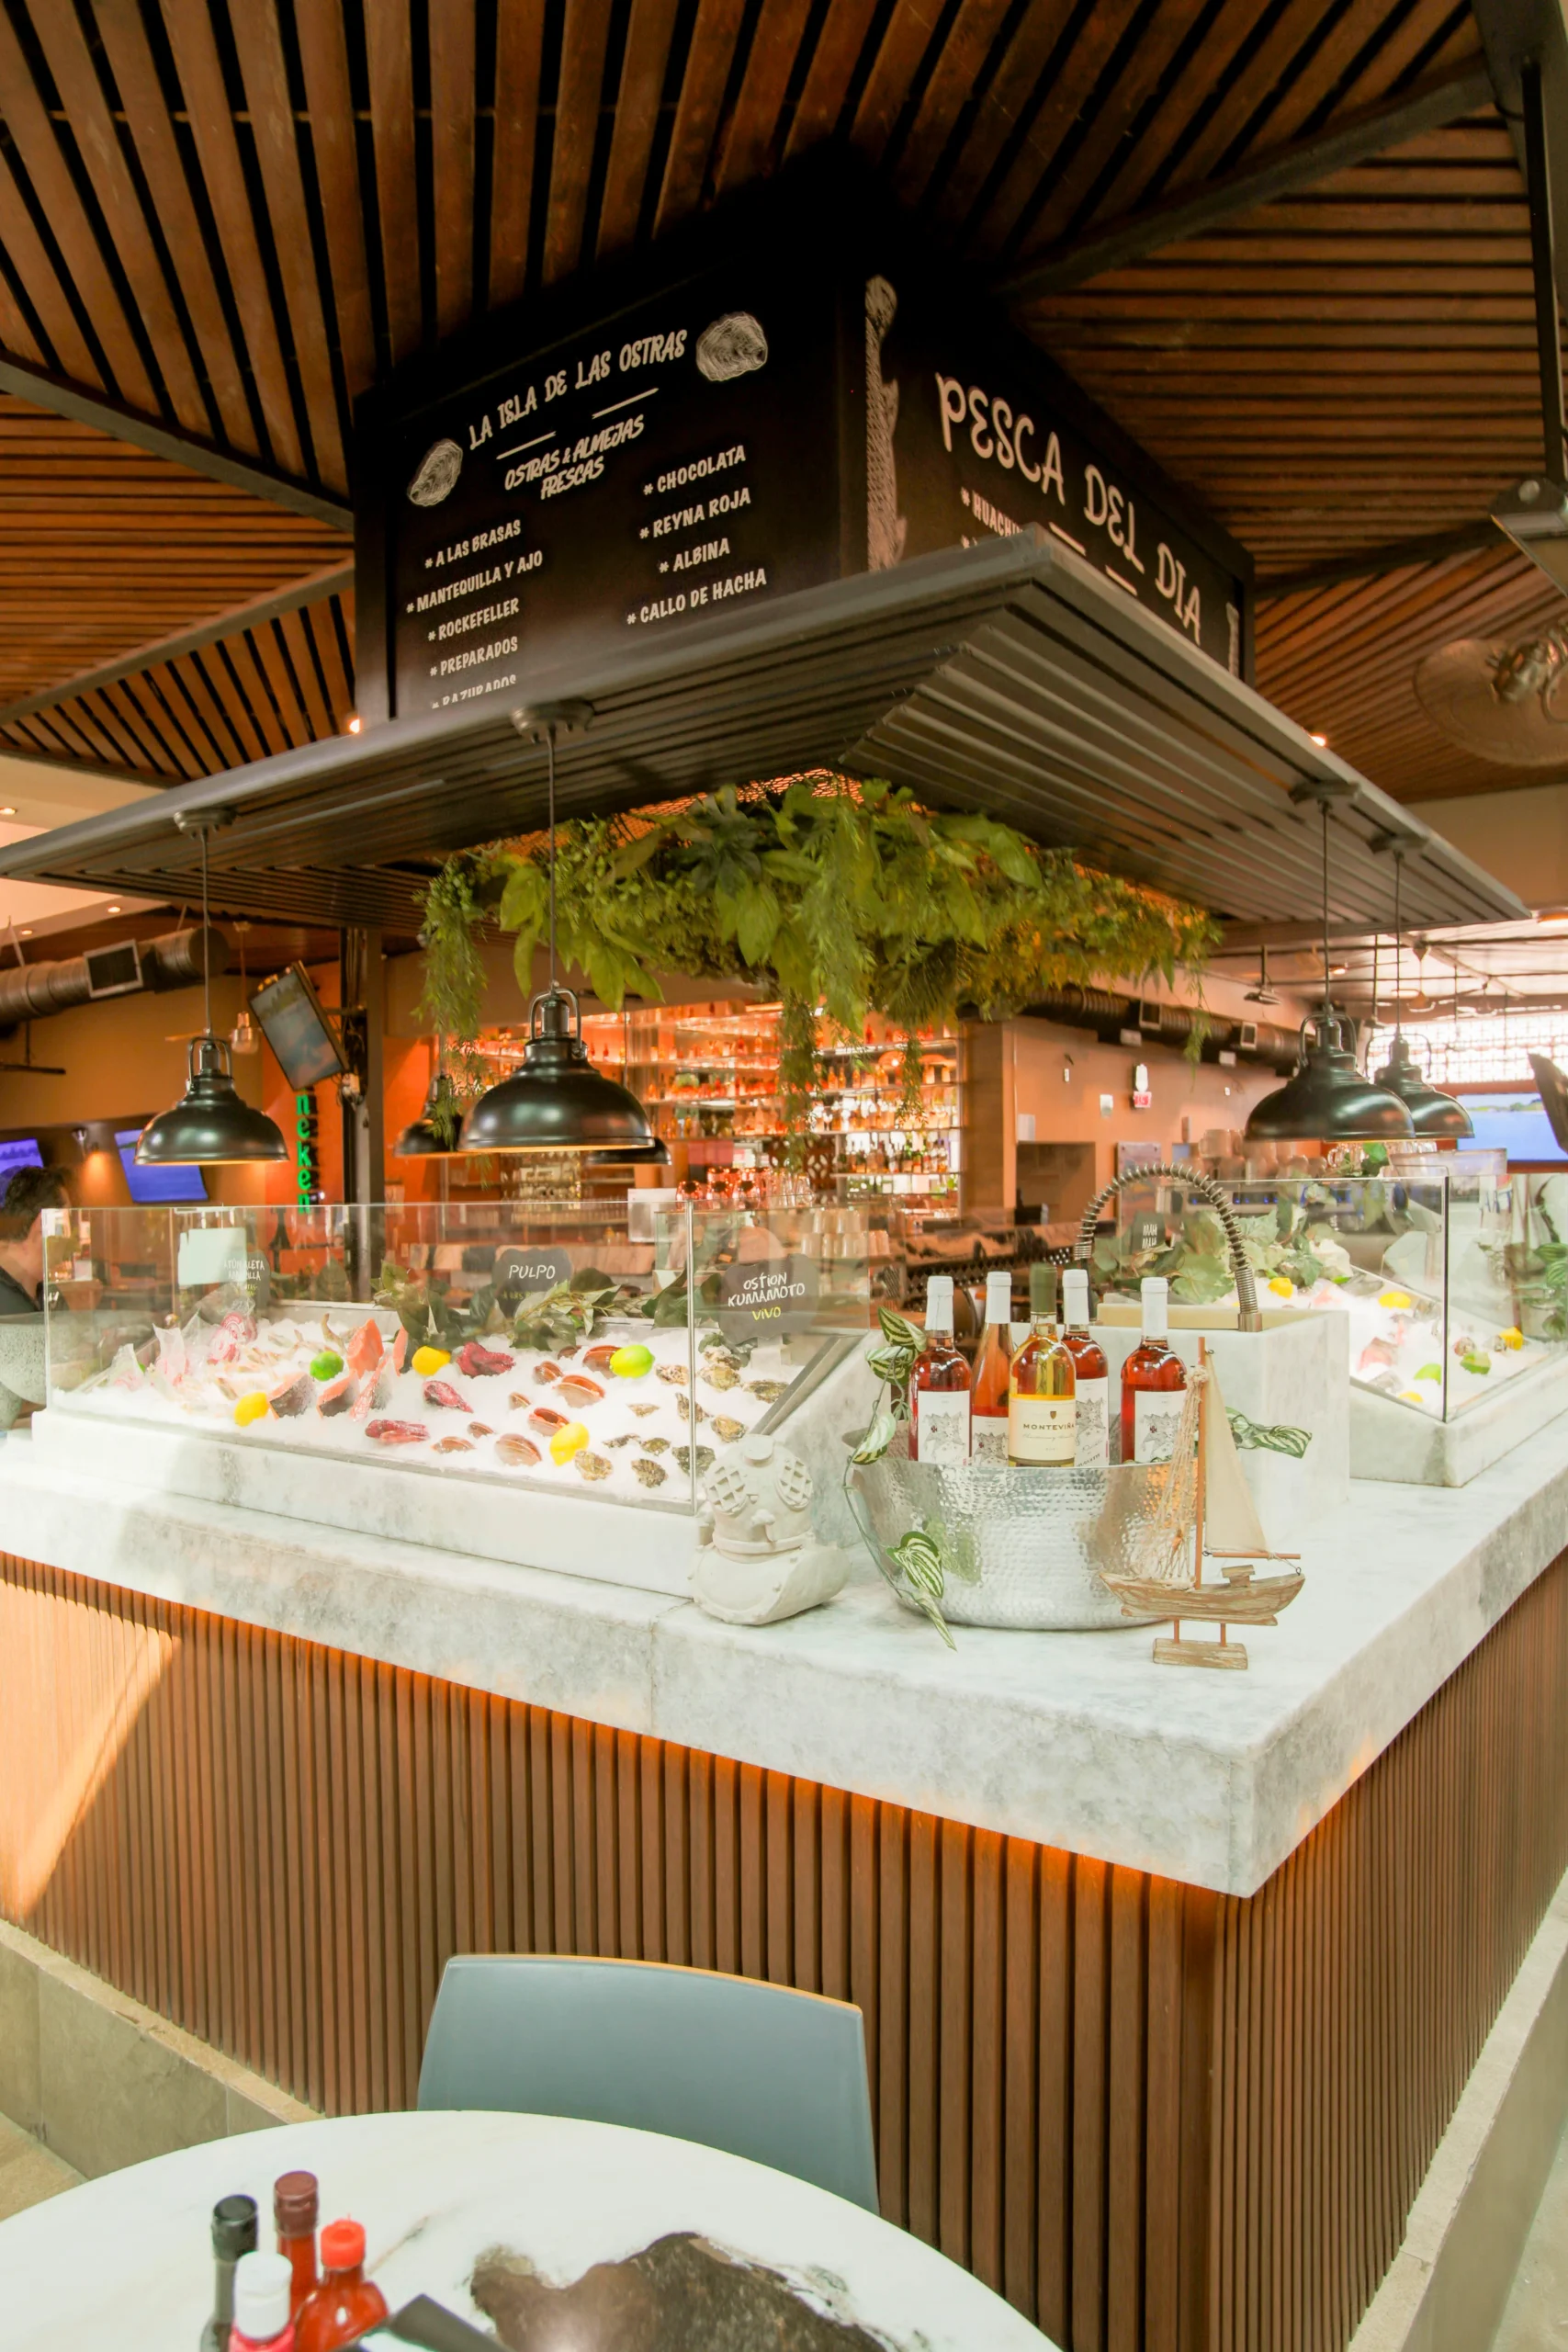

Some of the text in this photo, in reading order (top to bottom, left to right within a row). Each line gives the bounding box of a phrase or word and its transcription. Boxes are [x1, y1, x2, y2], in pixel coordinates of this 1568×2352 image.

[469, 329, 688, 450] LA ISLA DE LAS OSTRAS
[504, 413, 645, 491] OSTRAS & ALMEJAS
[657, 445, 747, 493] CHOCOLATA
[540, 455, 604, 501] FRESCAS
[652, 487, 751, 538] REYNA ROJA
[934, 371, 1202, 647] PESCA DEL DIA
[435, 519, 522, 568] A LAS BRASAS
[672, 537, 731, 572] ALBINA
[416, 549, 544, 613] MANTEQUILLA Y AJO
[640, 568, 768, 624] CALLO DE HACHA
[438, 597, 520, 641] ROCKEFELLER
[440, 636, 519, 676] PREPARADOS
[296, 1090, 312, 1215] neken
[508, 1264, 557, 1280] PULPO
[728, 1283, 806, 1307] KUMAMOTO
